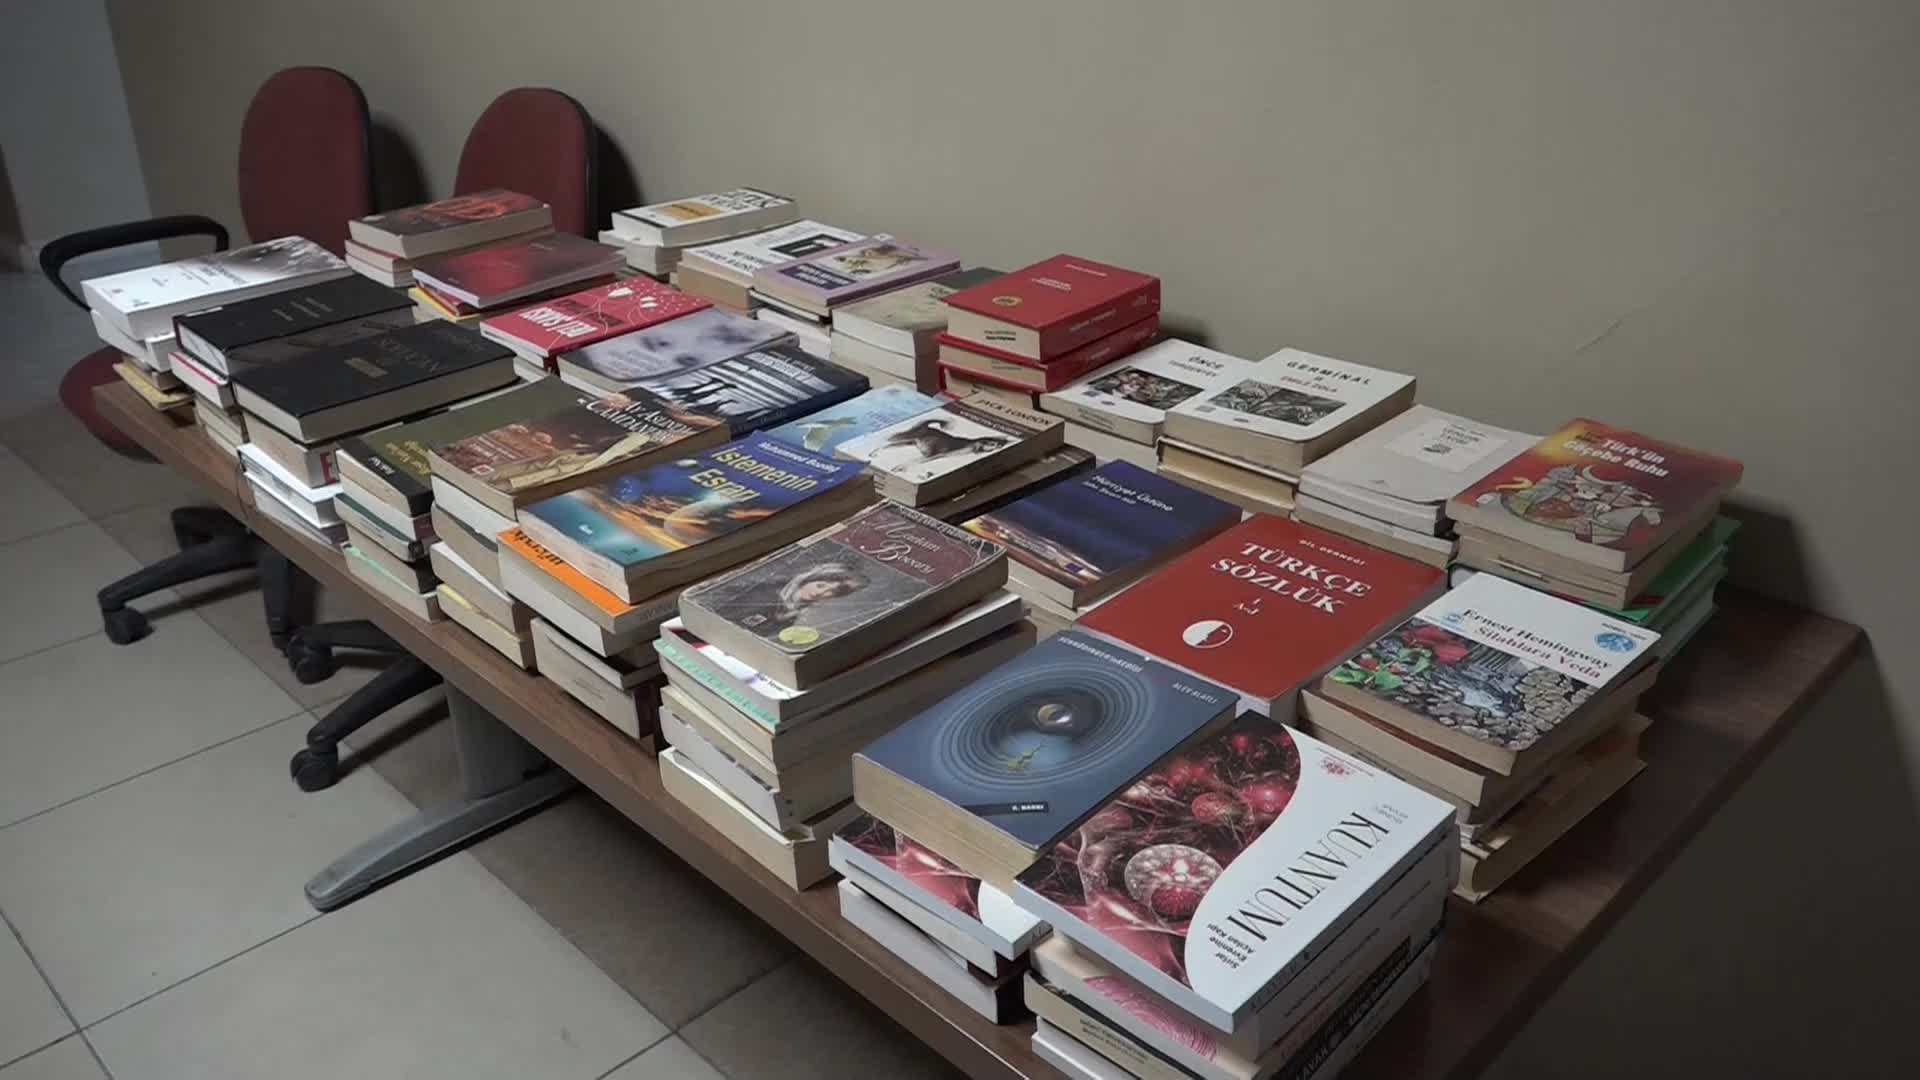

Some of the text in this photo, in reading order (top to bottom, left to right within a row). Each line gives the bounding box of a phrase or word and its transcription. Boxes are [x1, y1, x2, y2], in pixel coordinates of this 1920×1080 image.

[975, 399, 1054, 425] JACK LONDON
[711, 445, 819, 491] İstemenin
[1563, 439, 1623, 464] Göçebe
[1624, 456, 1669, 478] Ruhu
[1601, 439, 1666, 465] Türk'ün
[1091, 475, 1137, 496] Hürriyet
[859, 540, 937, 575] Bovary
[1240, 542, 1372, 597] TÜRKÇE
[1210, 558, 1345, 614] SÖZLÜK
[1463, 609, 1515, 633] Ernest
[1516, 628, 1613, 670] Hemingway
[1474, 626, 1601, 680] Silahlara Veda
[1226, 811, 1390, 942] KUANTUM
[1208, 936, 1248, 962] Evrenine
